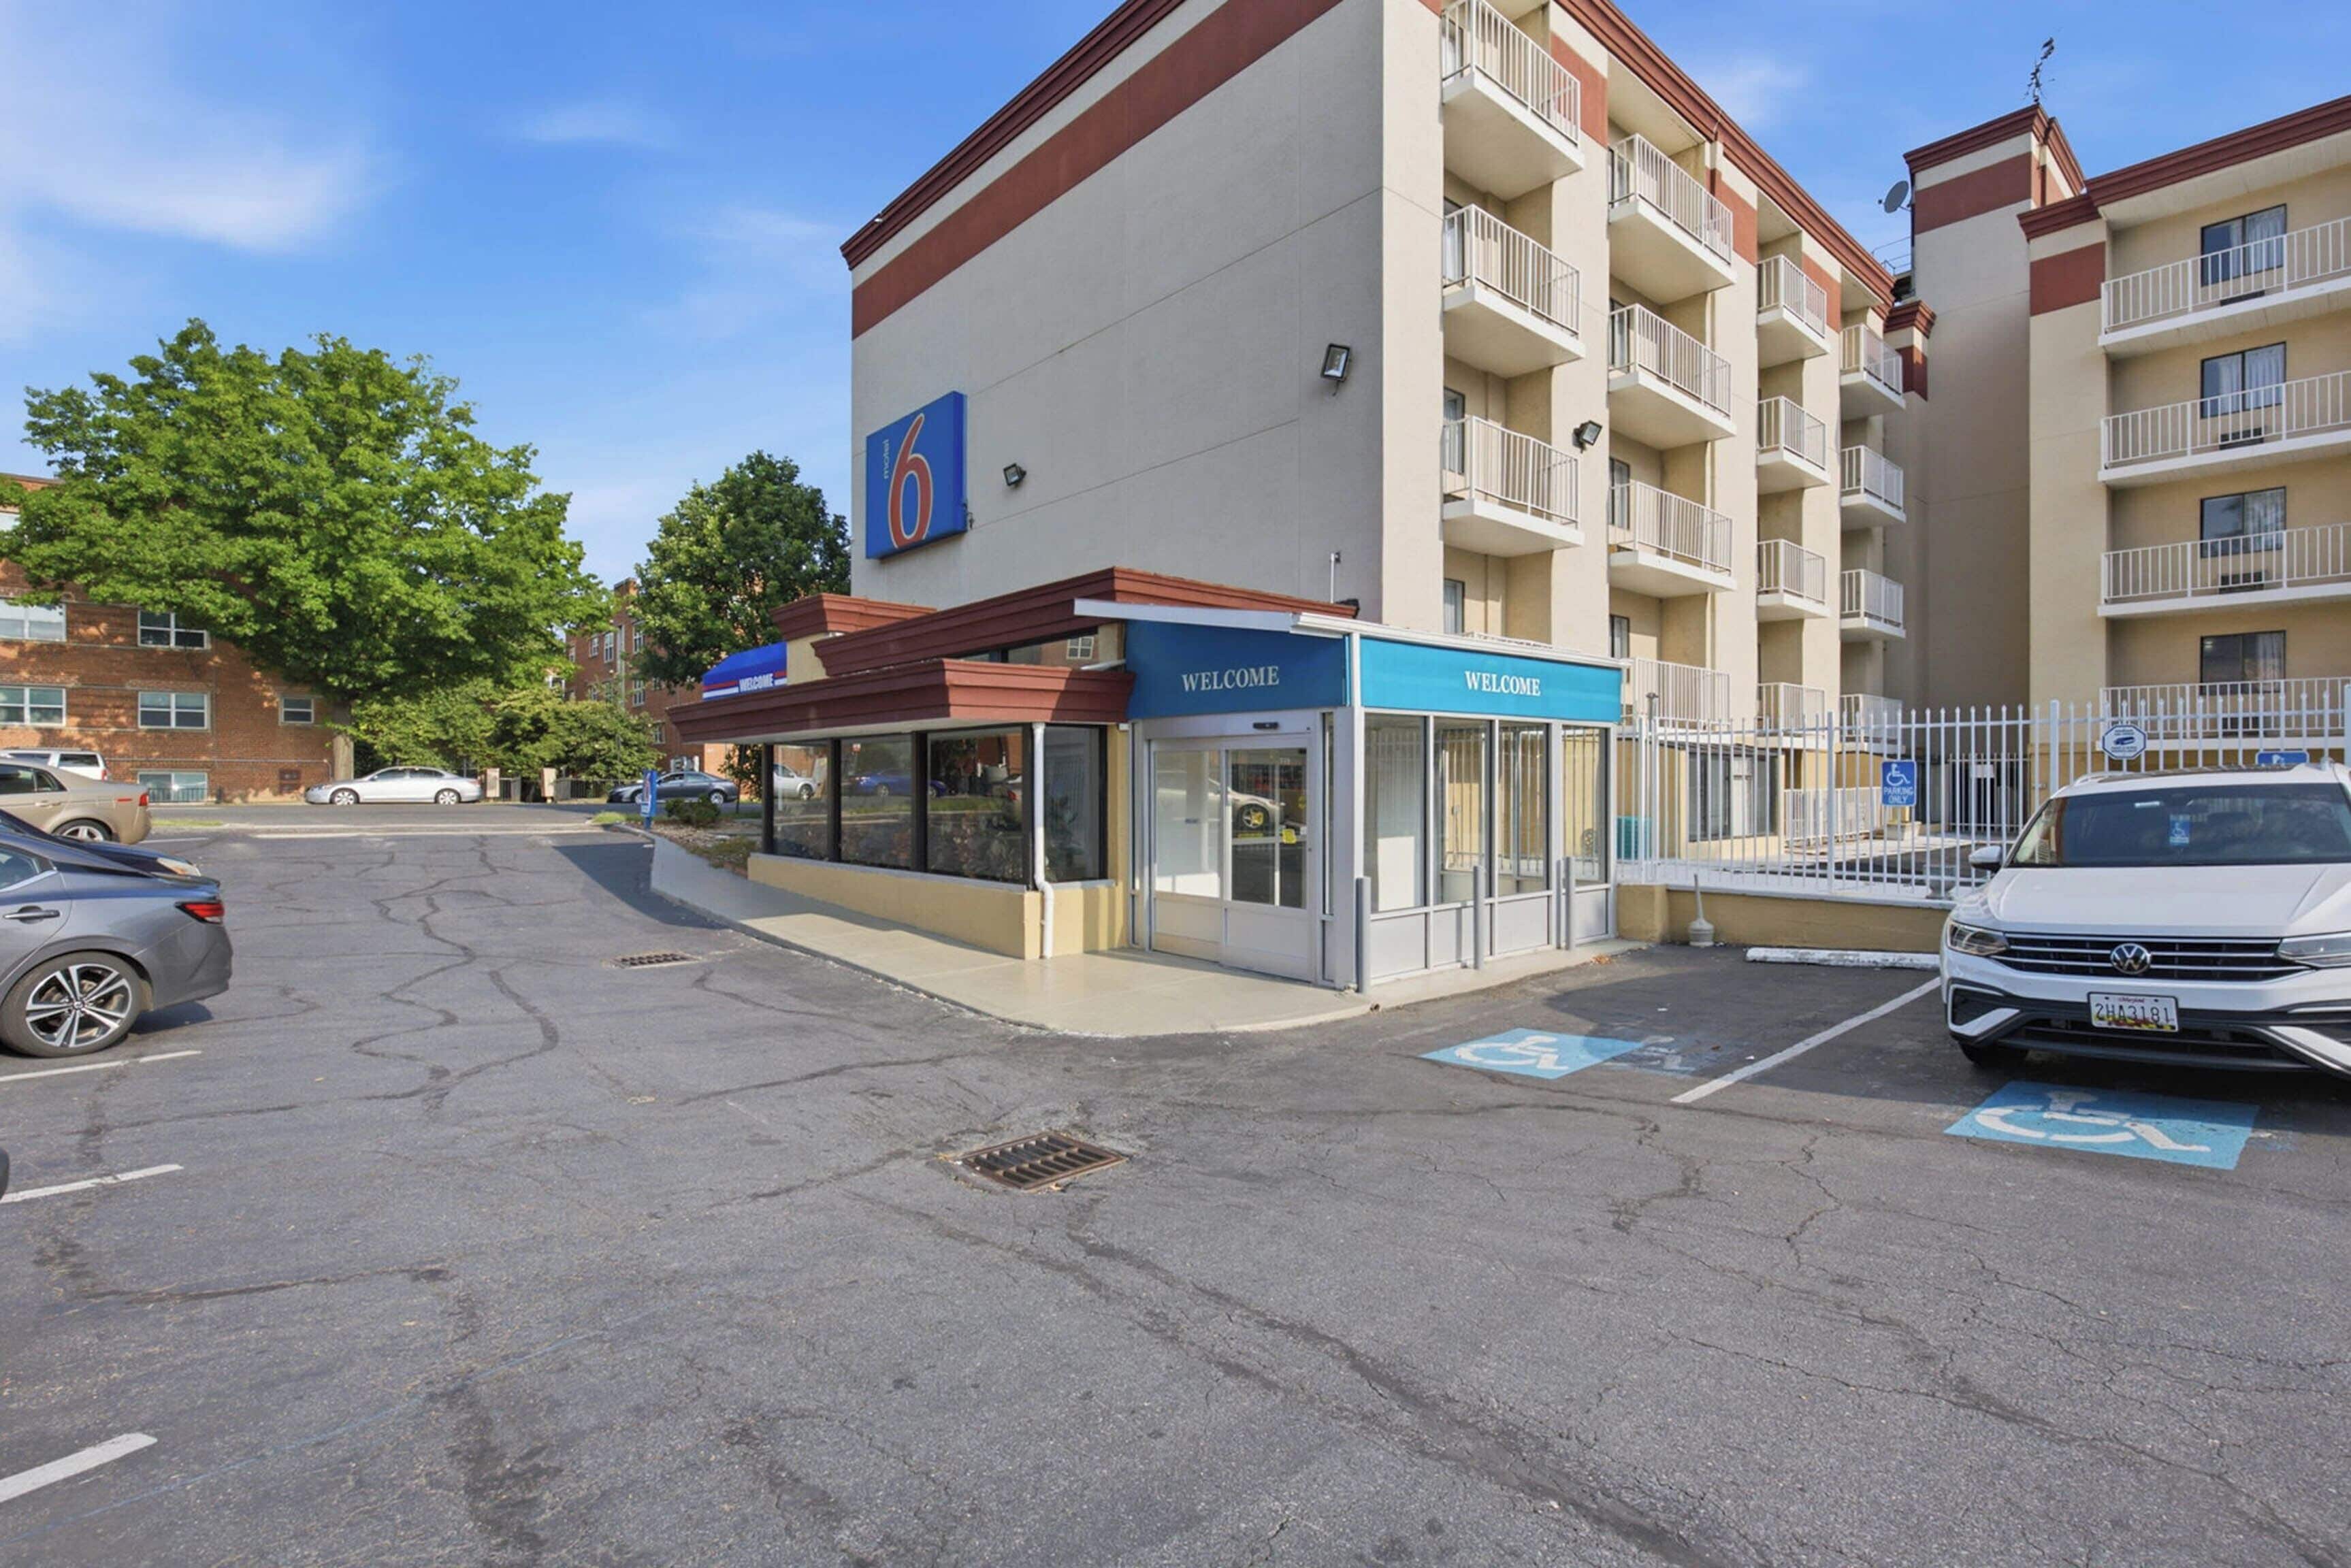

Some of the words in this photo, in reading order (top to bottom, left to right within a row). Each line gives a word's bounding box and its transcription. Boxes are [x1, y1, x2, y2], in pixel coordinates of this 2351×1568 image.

[888, 412, 933, 549] 6
[739, 673, 774, 692] WELCOME
[1182, 666, 1280, 692] WELCOME
[1465, 670, 1541, 696] WELCOME
[1883, 786, 1913, 795] PARKING
[1889, 795, 1909, 804] ONLY
[2095, 1003, 2170, 1023] 2HA3181
